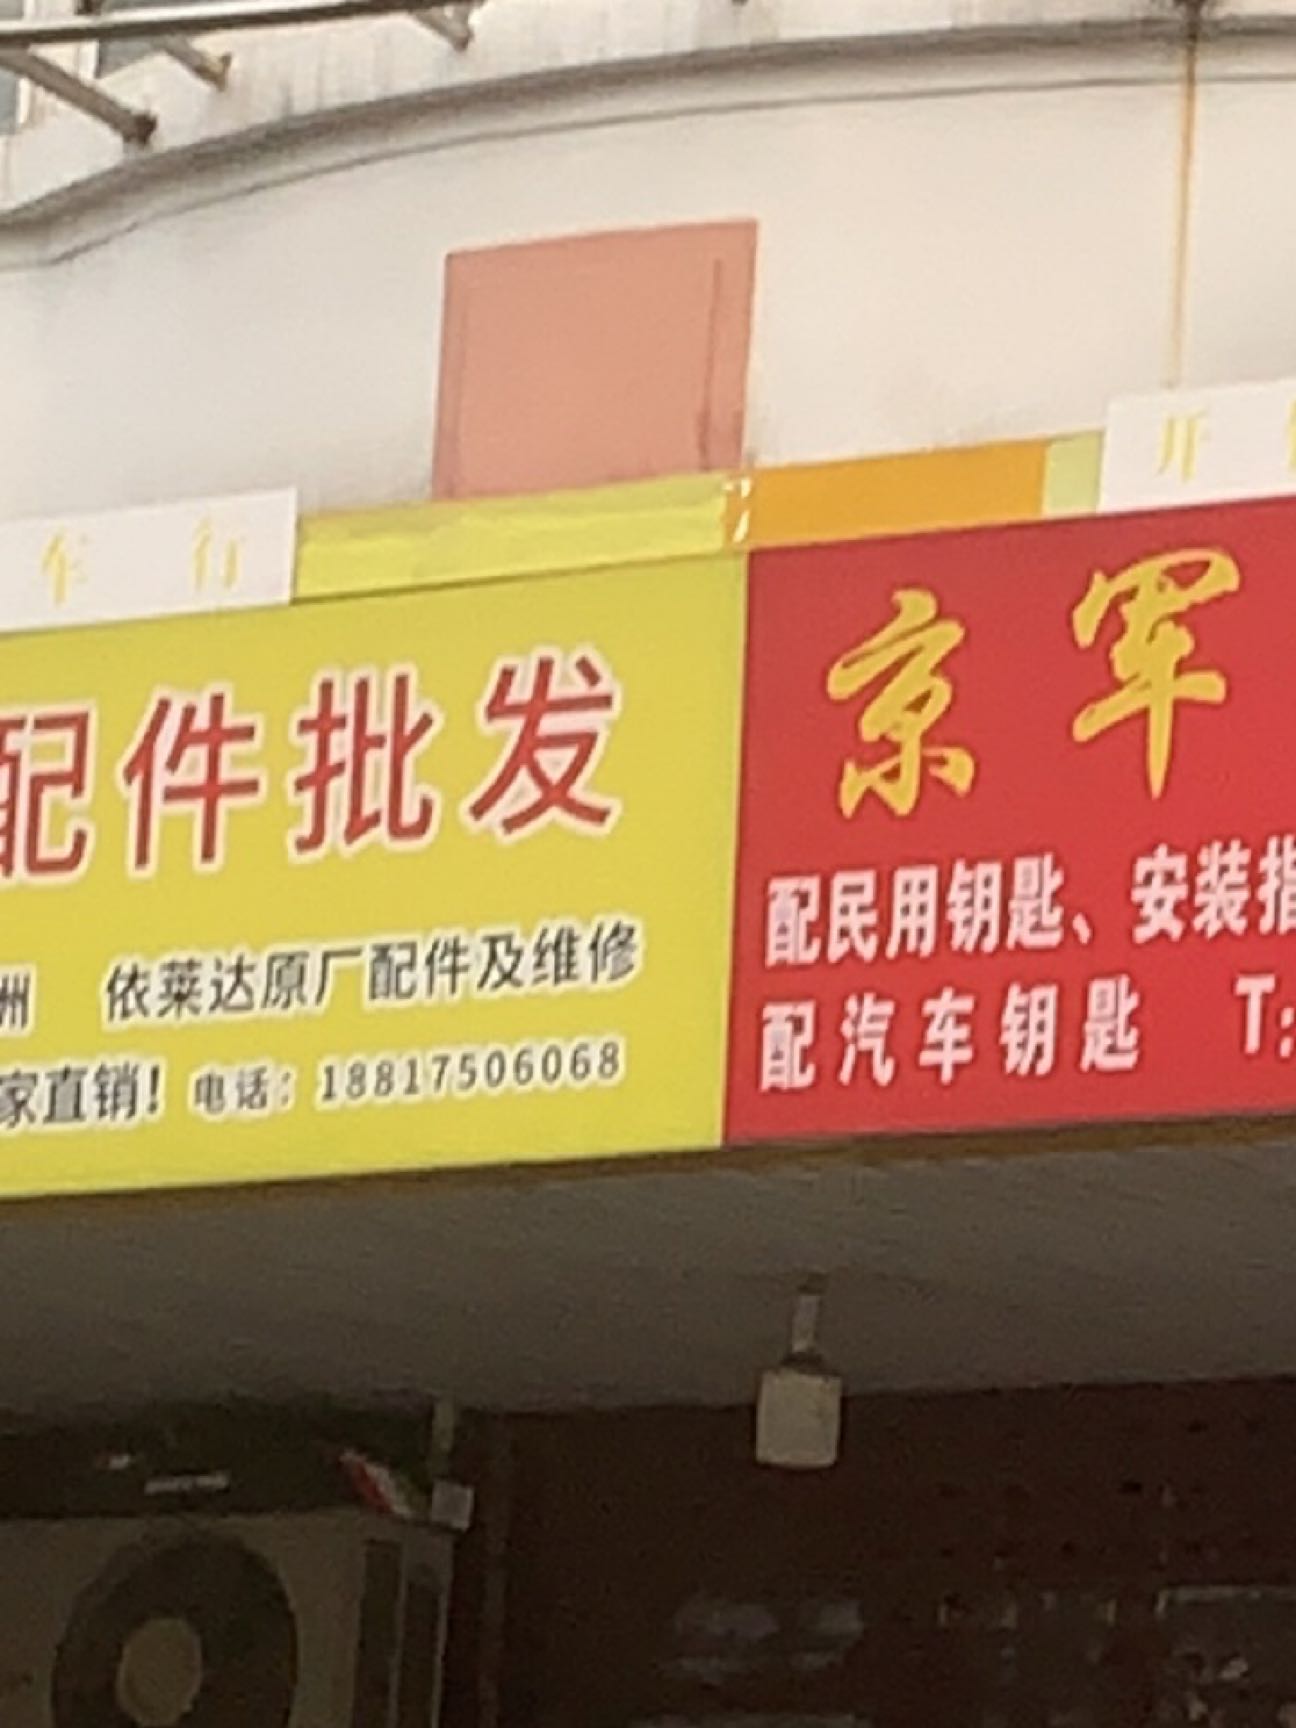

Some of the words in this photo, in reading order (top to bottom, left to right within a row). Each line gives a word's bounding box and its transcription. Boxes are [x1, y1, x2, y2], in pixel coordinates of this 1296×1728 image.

[0, 652, 618, 880] 配件批发
[106, 922, 640, 1023] 依莱达原厂配件及维修
[320, 1040, 622, 1102] 18817506068
[758, 973, 1142, 1092] 配汽车钥匙
